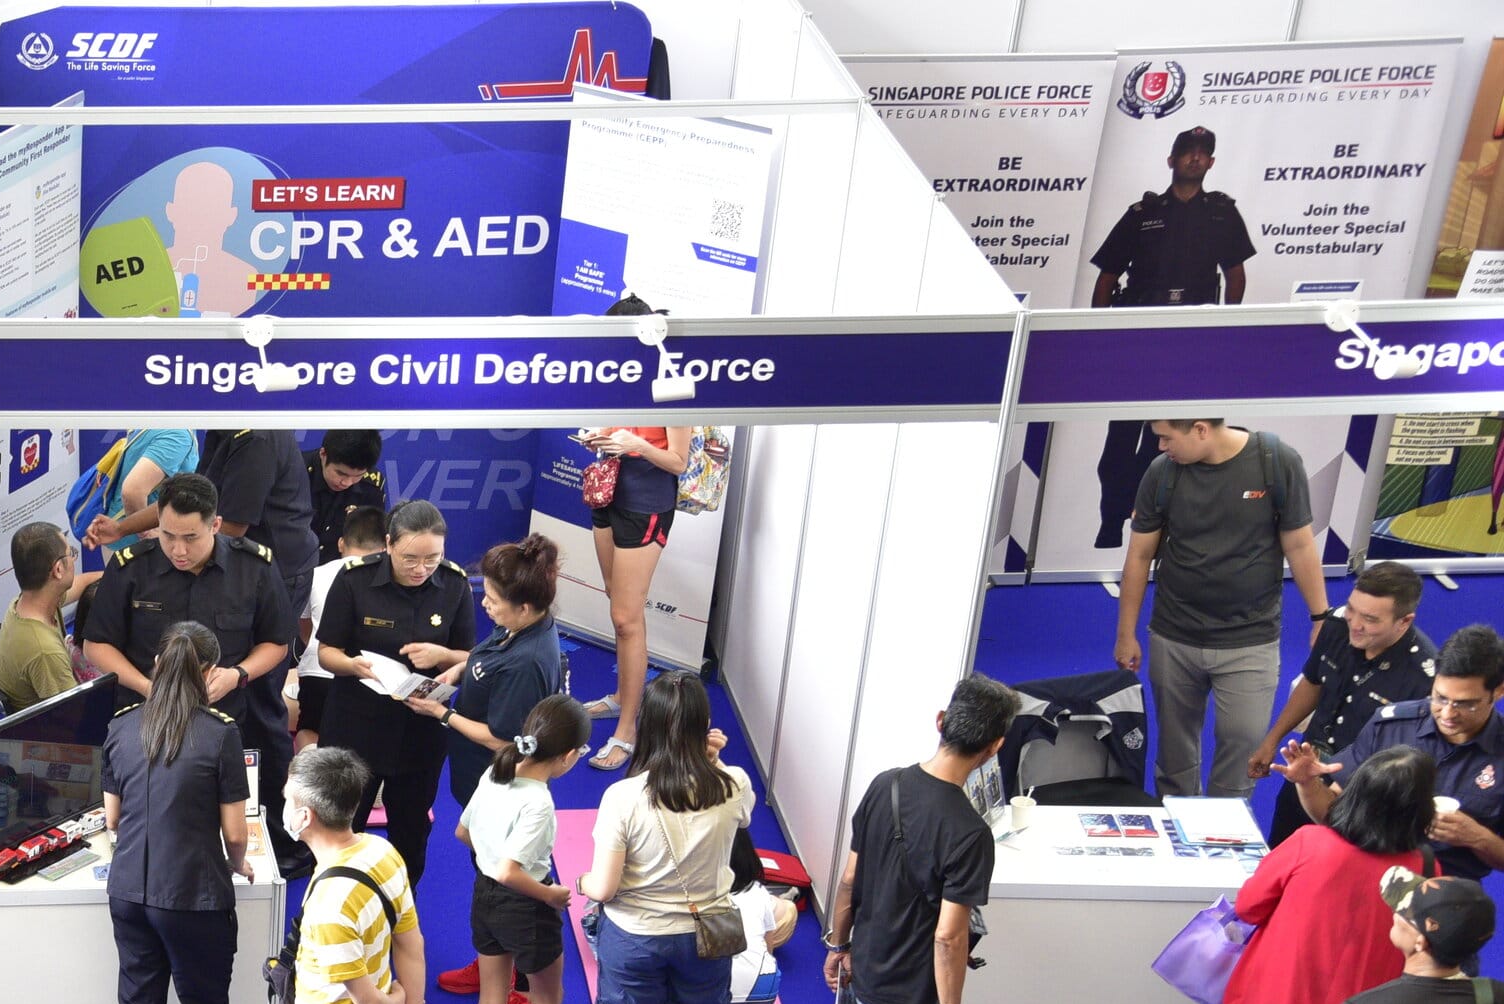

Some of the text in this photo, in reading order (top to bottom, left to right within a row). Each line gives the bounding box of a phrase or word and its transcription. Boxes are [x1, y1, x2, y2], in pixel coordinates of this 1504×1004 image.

[66, 33, 158, 58] SCDF
[67, 62, 155, 73] The Life Saving Force
[1202, 65, 1437, 88] SINGAPORE POLICE FORCE
[868, 85, 1093, 101] SINGAPORE POLICE FORCE
[1199, 88, 1432, 105] SAFEGUARDING EVERY DAY
[875, 107, 1090, 119] AFEGUARDING EVERY DAY
[582, 120, 633, 138] Programme
[7, 151, 17, 160] the
[18, 131, 53, 157] myResponder
[54, 126, 65, 137] App
[30, 150, 42, 161] First
[43, 134, 71, 155] Responder
[1333, 144, 1359, 158] BE
[997, 157, 1023, 171] BE
[1264, 163, 1427, 181] EXTRAORDINARY
[324, 184, 396, 202] LEARN
[933, 177, 1088, 193] EXTRAORDINARY
[1303, 203, 1369, 217] Join the
[971, 215, 1035, 228] Join the
[1260, 220, 1406, 237] Volunteer Special
[250, 214, 550, 261] CPR & AED
[1011, 234, 1069, 249] Special
[1273, 241, 1383, 257] Constabulary
[96, 255, 145, 285] AED
[144, 352, 775, 393] Singaore Civil Defence Force
[655, 601, 677, 614] SCDF
